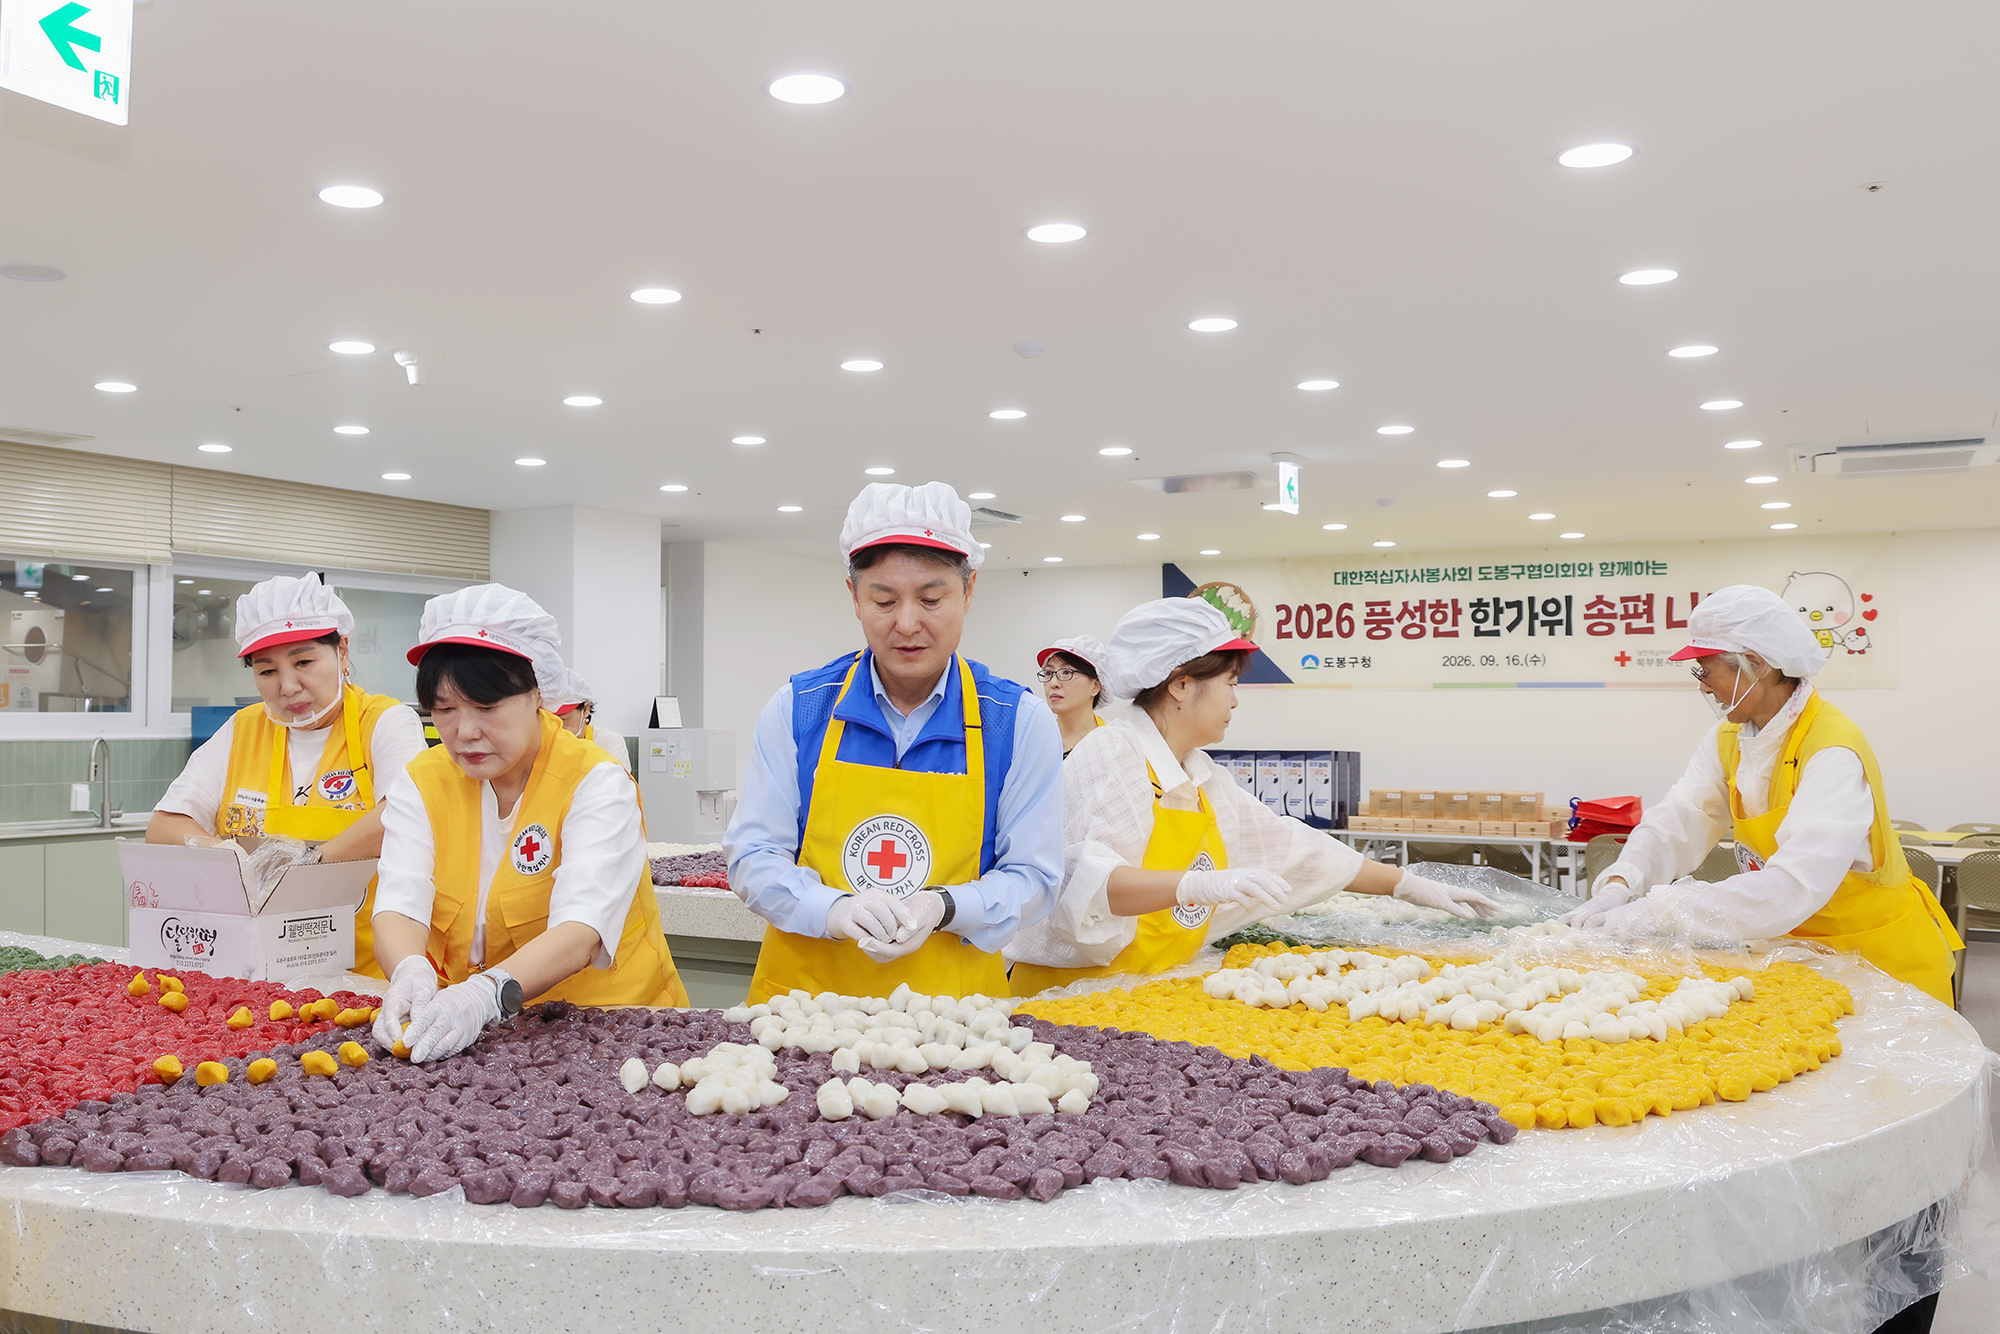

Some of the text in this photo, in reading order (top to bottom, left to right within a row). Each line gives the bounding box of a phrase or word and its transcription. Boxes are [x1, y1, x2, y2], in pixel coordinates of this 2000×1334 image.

[1333, 560, 1668, 586] 대한적십자사봉사회 도봉구협의회와 함께하는
[1275, 602, 1355, 640] 2026
[1363, 598, 1463, 641] 풍성한
[1469, 594, 1574, 637] 한가위
[1583, 592, 1655, 637] 송편
[1323, 656, 1372, 669] 도봉구청
[1442, 655, 1475, 667] 2026.
[1480, 655, 1499, 667] 09.
[513, 829, 528, 848] KOREAN
[535, 825, 548, 839] CROSS
[849, 821, 925, 862] KOREAN RED CROSS
[516, 854, 550, 873] 대한적십자사
[288, 920, 329, 939] 웰빙떡전문
